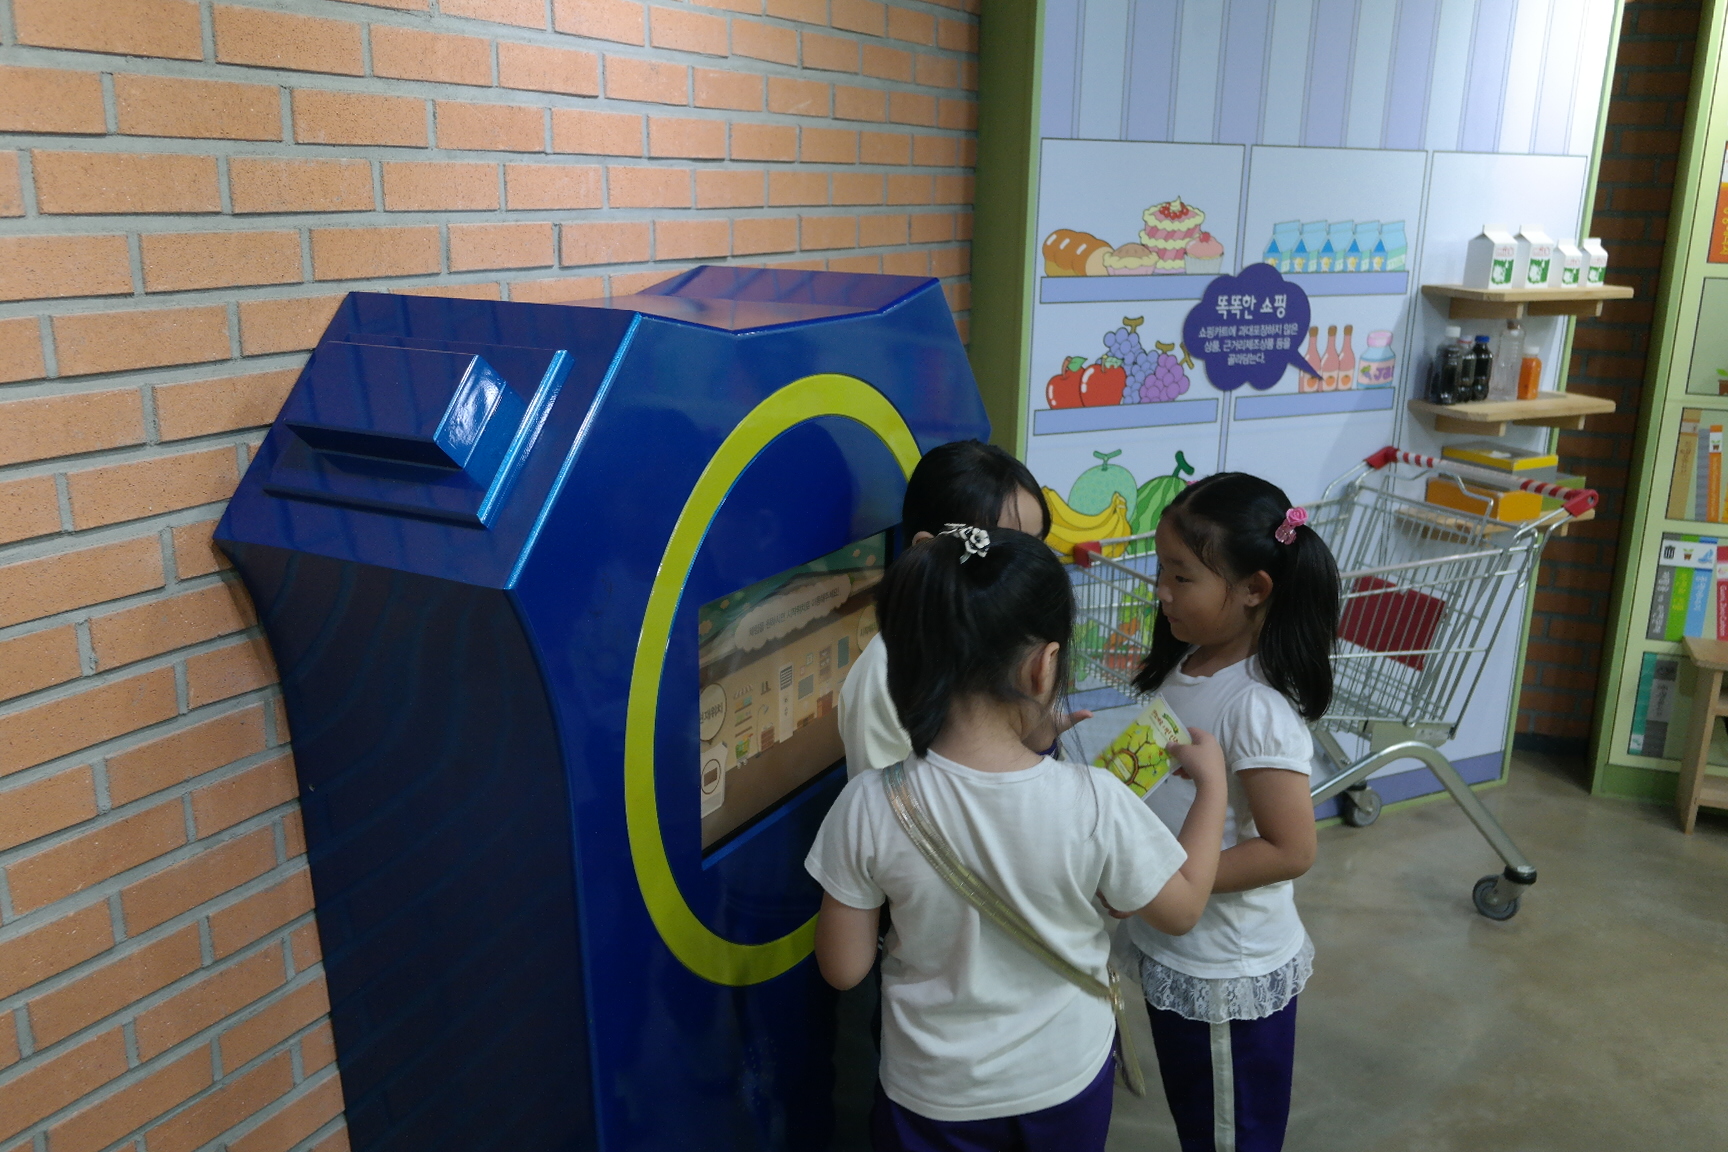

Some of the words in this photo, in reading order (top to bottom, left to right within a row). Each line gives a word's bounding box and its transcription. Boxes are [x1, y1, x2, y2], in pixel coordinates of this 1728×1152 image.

[1216, 294, 1257, 319] 똑똑한
[1260, 294, 1287, 318] 쇼핑
[1198, 325, 1237, 339] 쇼핑카트에
[1239, 323, 1282, 337] 과대포장하지
[1284, 323, 1298, 335] 않은
[1275, 336, 1291, 350] 등을
